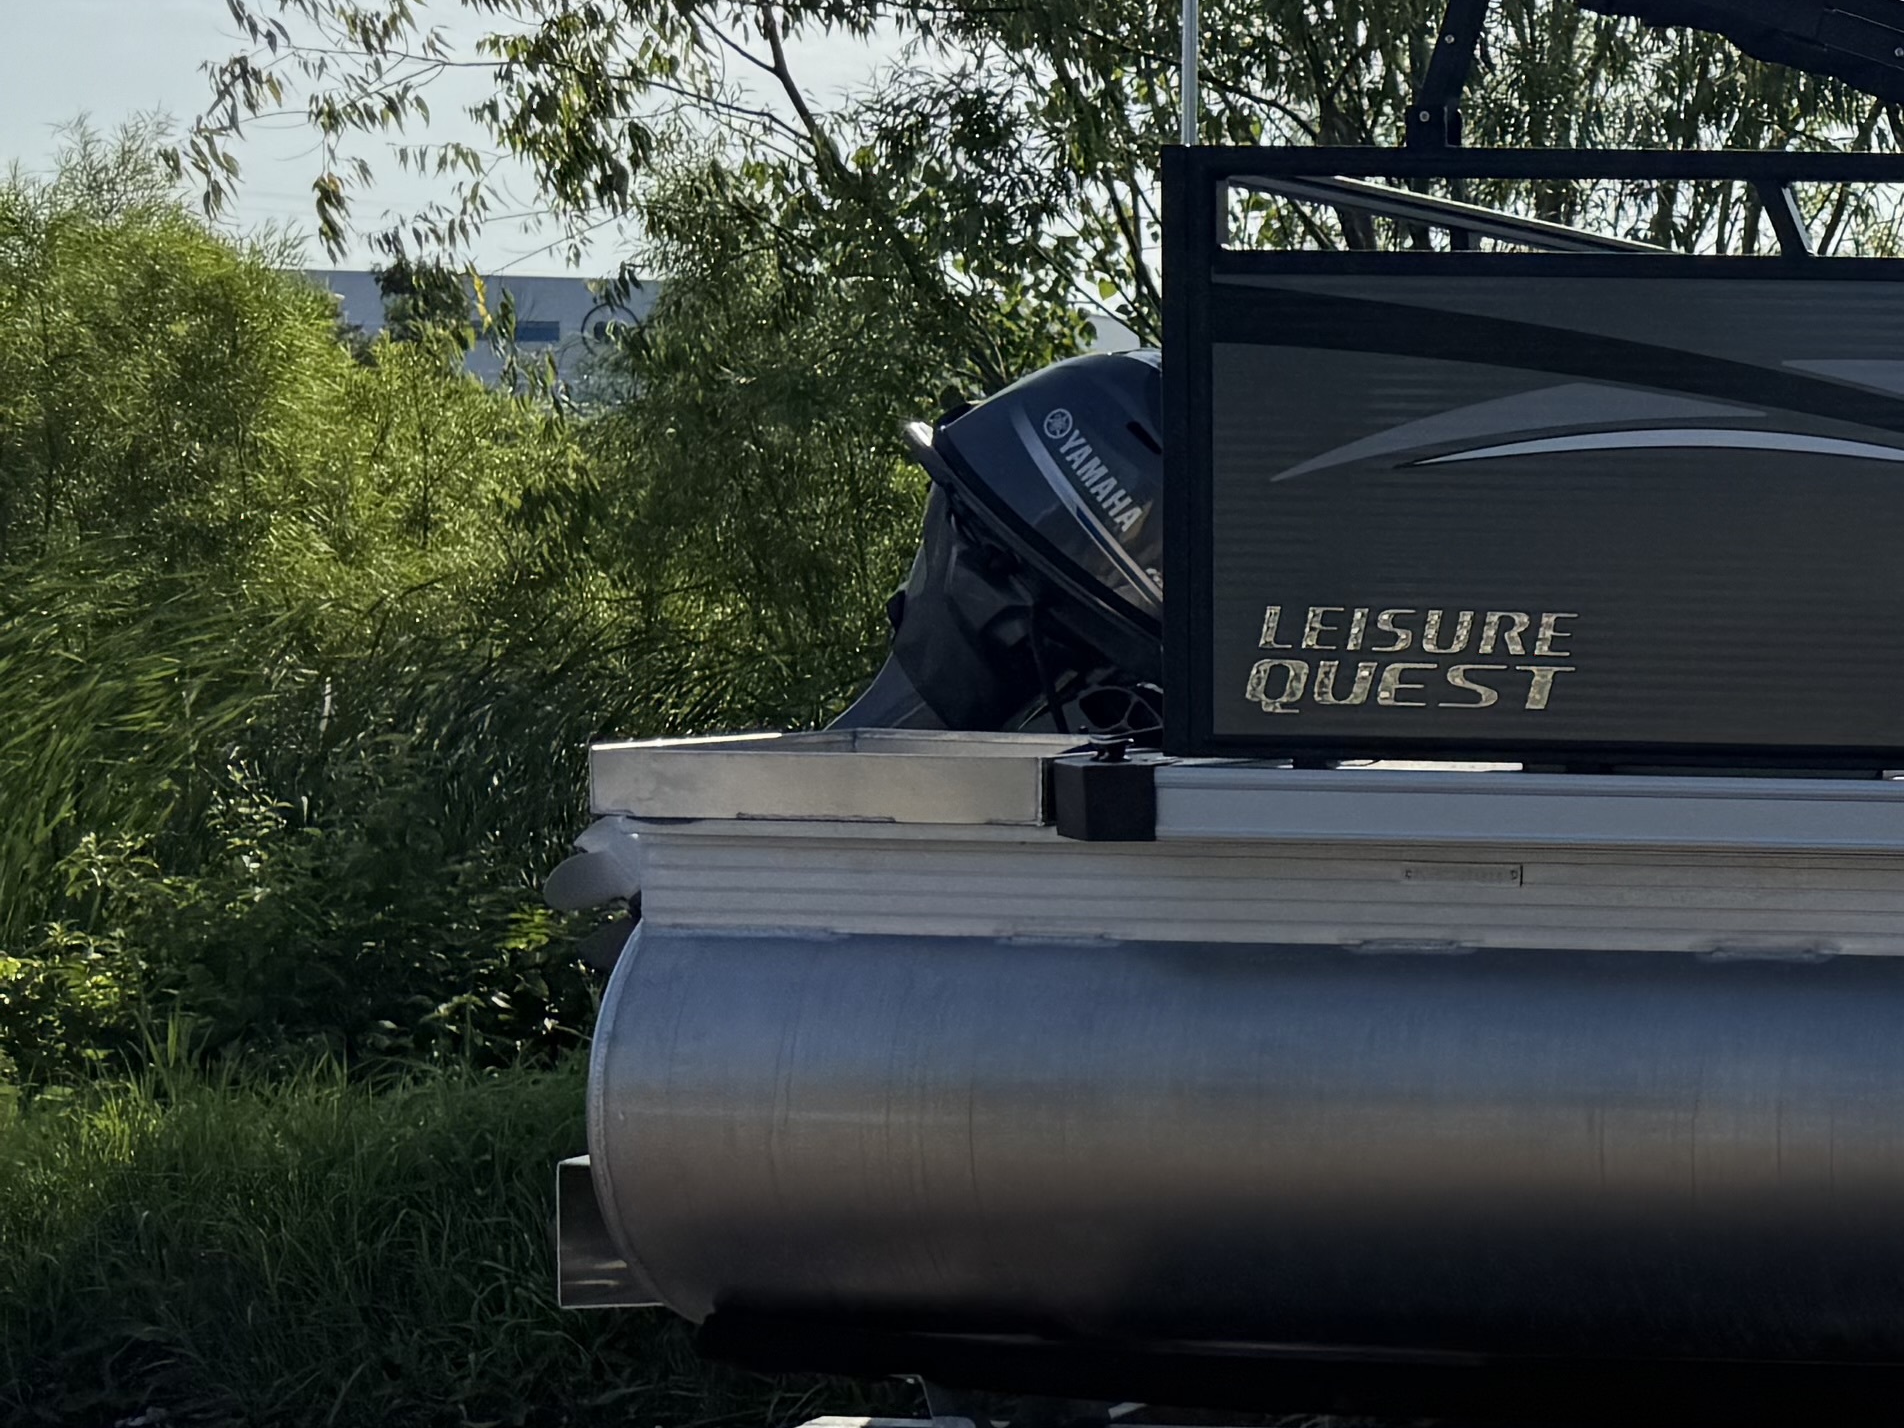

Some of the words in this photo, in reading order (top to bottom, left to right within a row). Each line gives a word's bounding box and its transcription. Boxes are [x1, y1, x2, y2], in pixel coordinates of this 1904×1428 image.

[1059, 429, 1144, 533] YAMAHA
[1258, 605, 1580, 657] LEISURE
[1245, 659, 1576, 713] QUEST
